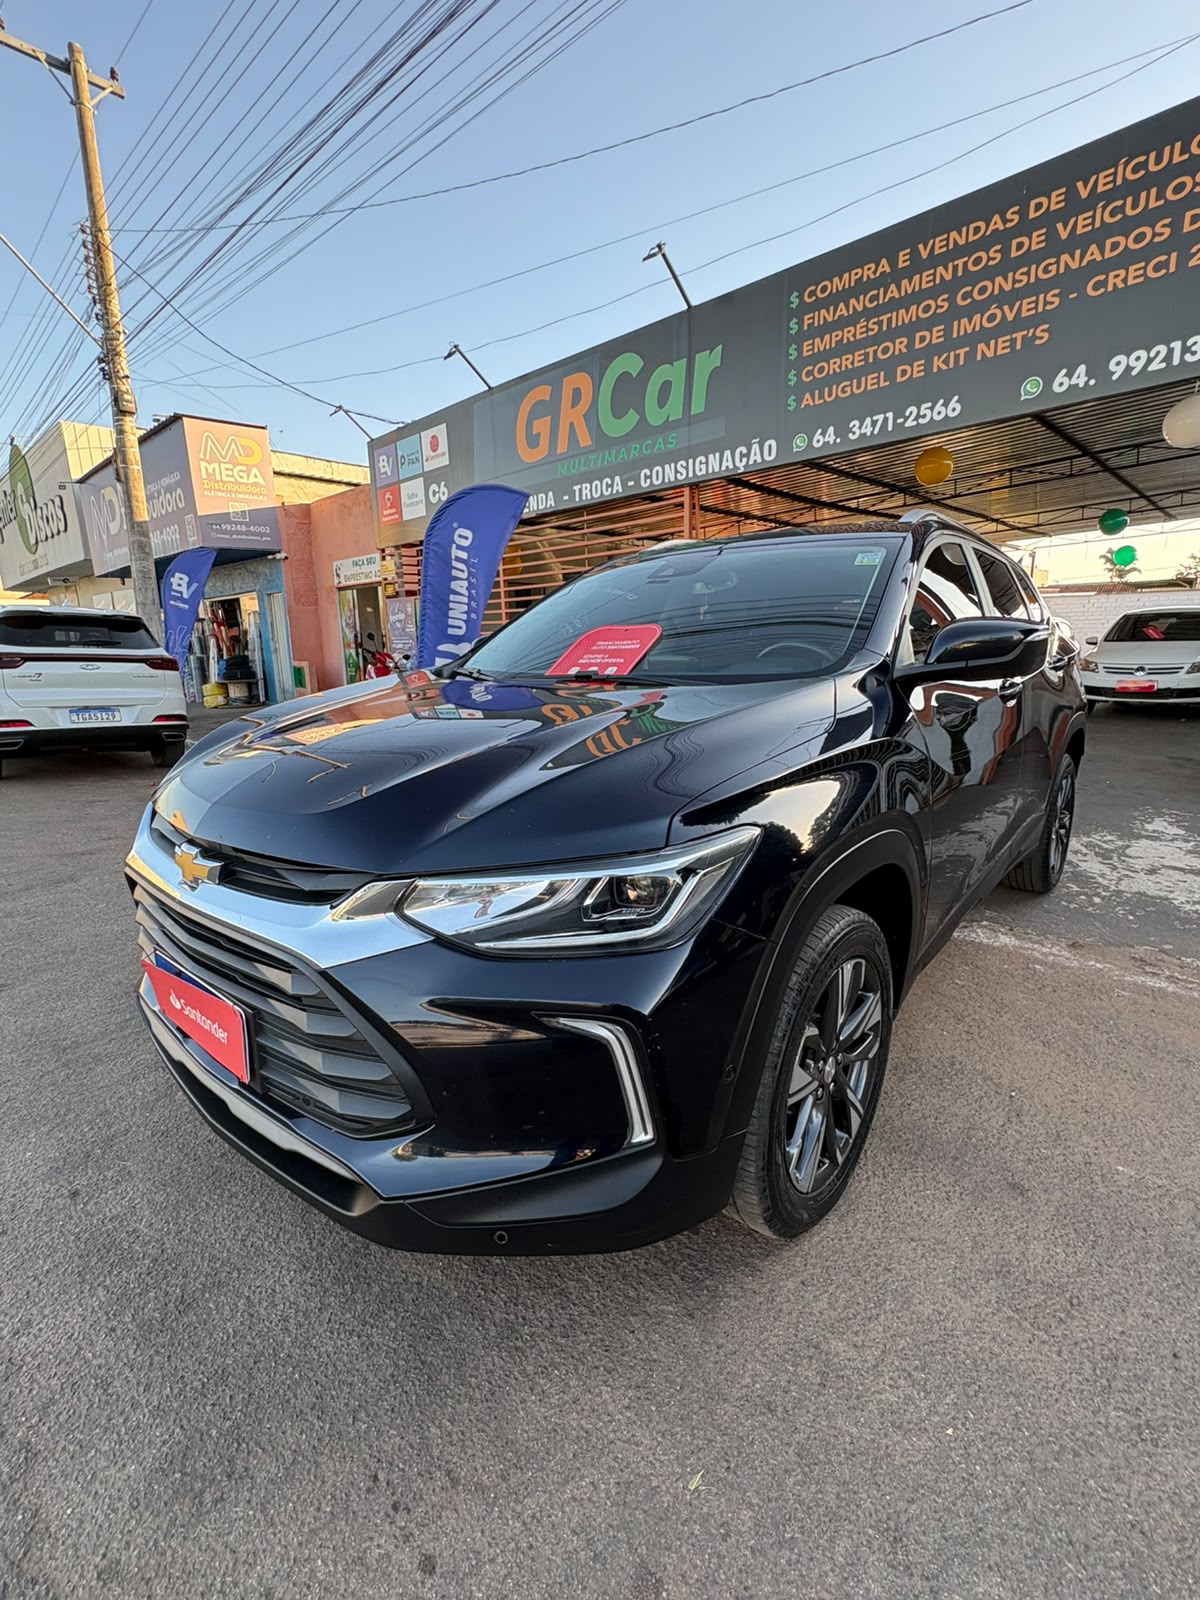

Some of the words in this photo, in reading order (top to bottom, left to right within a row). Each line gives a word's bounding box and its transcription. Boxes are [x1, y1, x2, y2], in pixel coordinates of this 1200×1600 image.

[803, 258, 891, 304] COMPRA
[898, 248, 911, 268] E
[918, 206, 1020, 260] VENDAS
[1028, 187, 1067, 219] DE
[802, 294, 950, 357] EMPRÉSTIMOS
[956, 218, 1172, 306] CONSIGNADOS
[803, 245, 1002, 331] FINANCIAMENTOS
[1010, 228, 1047, 258] DE
[801, 337, 908, 382] CORRETOR
[915, 325, 945, 349] DE
[952, 288, 1060, 338] IMÓVEIS
[1086, 251, 1178, 297] CRECI
[801, 371, 890, 408] ALUGUEL
[897, 360, 925, 383] DE
[933, 347, 970, 373] KIT
[976, 324, 1050, 360] NET'S
[1052, 363, 1096, 392] 64.
[515, 344, 723, 464] GRCar
[812, 425, 840, 448] 64.
[848, 395, 962, 440] 3471-2566
[199, 460, 266, 485] MEGA
[203, 480, 267, 494] Distribuidora
[556, 433, 677, 477] MULTIMARCAS
[573, 476, 623, 502] TROCA
[640, 437, 777, 487] CONSIGNAÇÃO
[352, 559, 365, 570] FAÇA
[448, 527, 473, 636] UNIAUTO
[470, 556, 479, 620] BRASIL
[180, 998, 228, 1045] Santander
